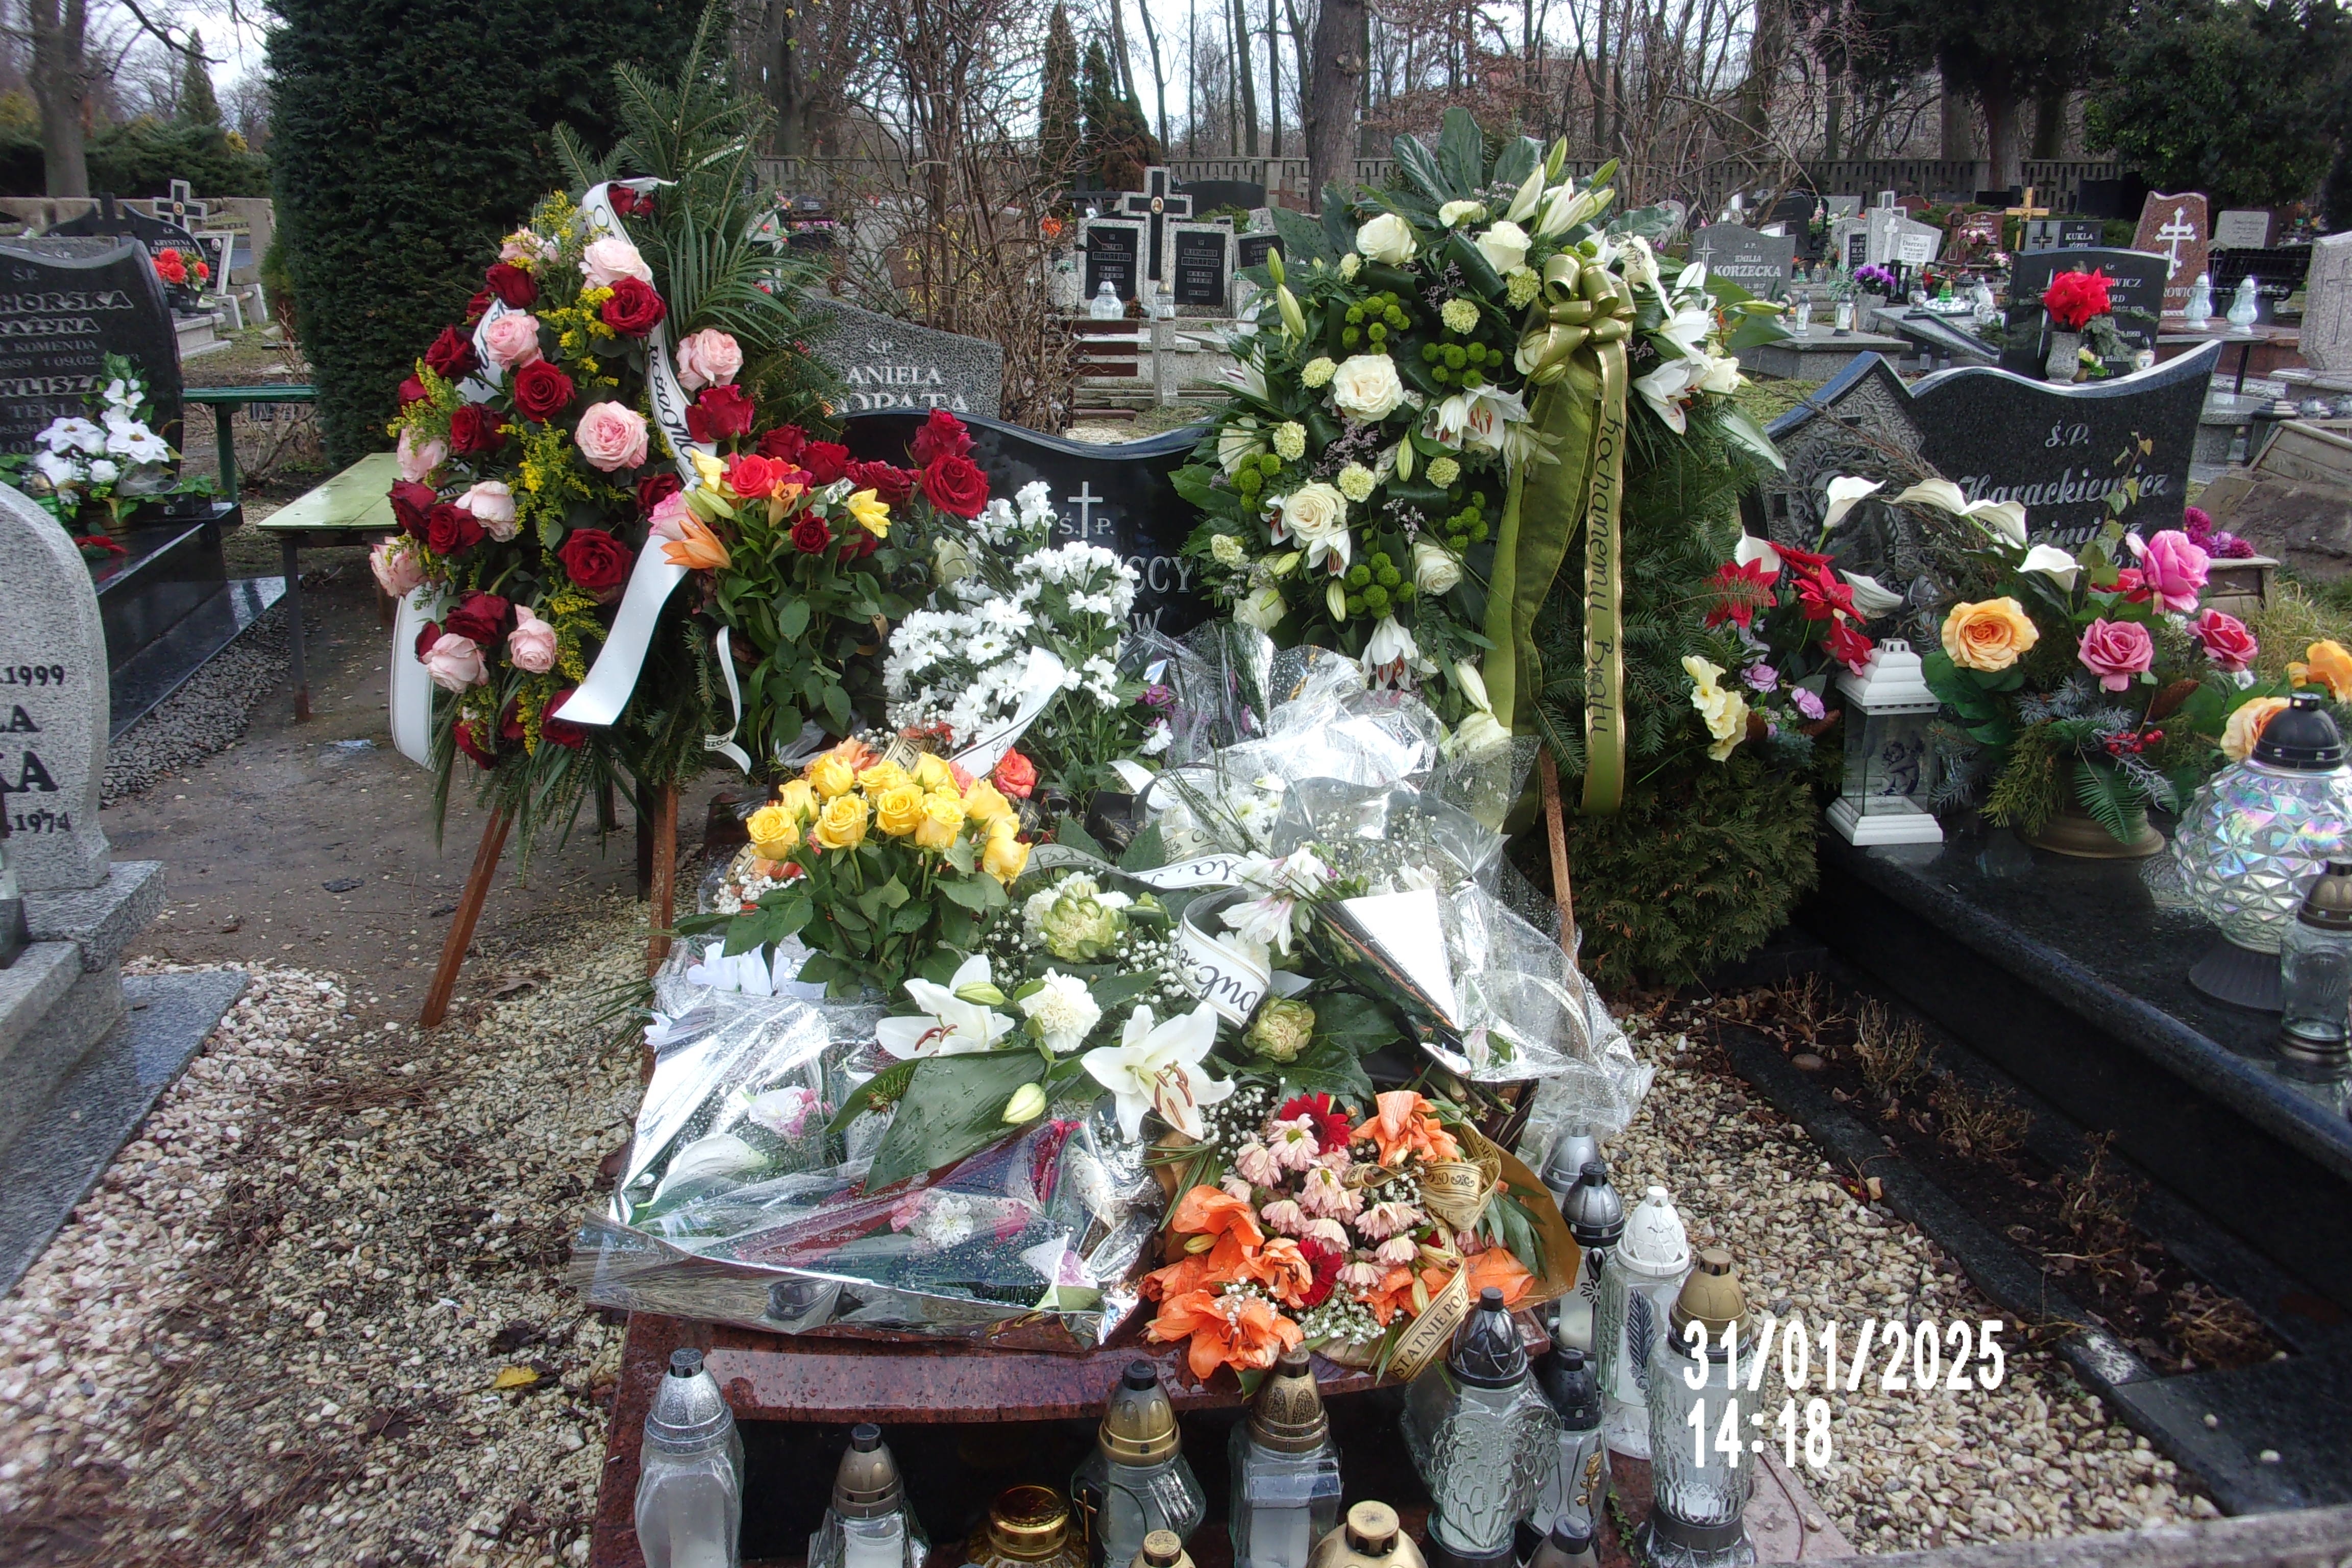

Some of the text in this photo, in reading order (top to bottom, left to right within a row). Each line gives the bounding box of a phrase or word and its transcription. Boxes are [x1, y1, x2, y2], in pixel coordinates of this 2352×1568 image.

[2065, 232, 2094, 240] KUKLA
[1712, 265, 1782, 277] KORZECKA
[2112, 278, 2142, 288] WICZ
[1588, 399, 1624, 621] Kochanemu
